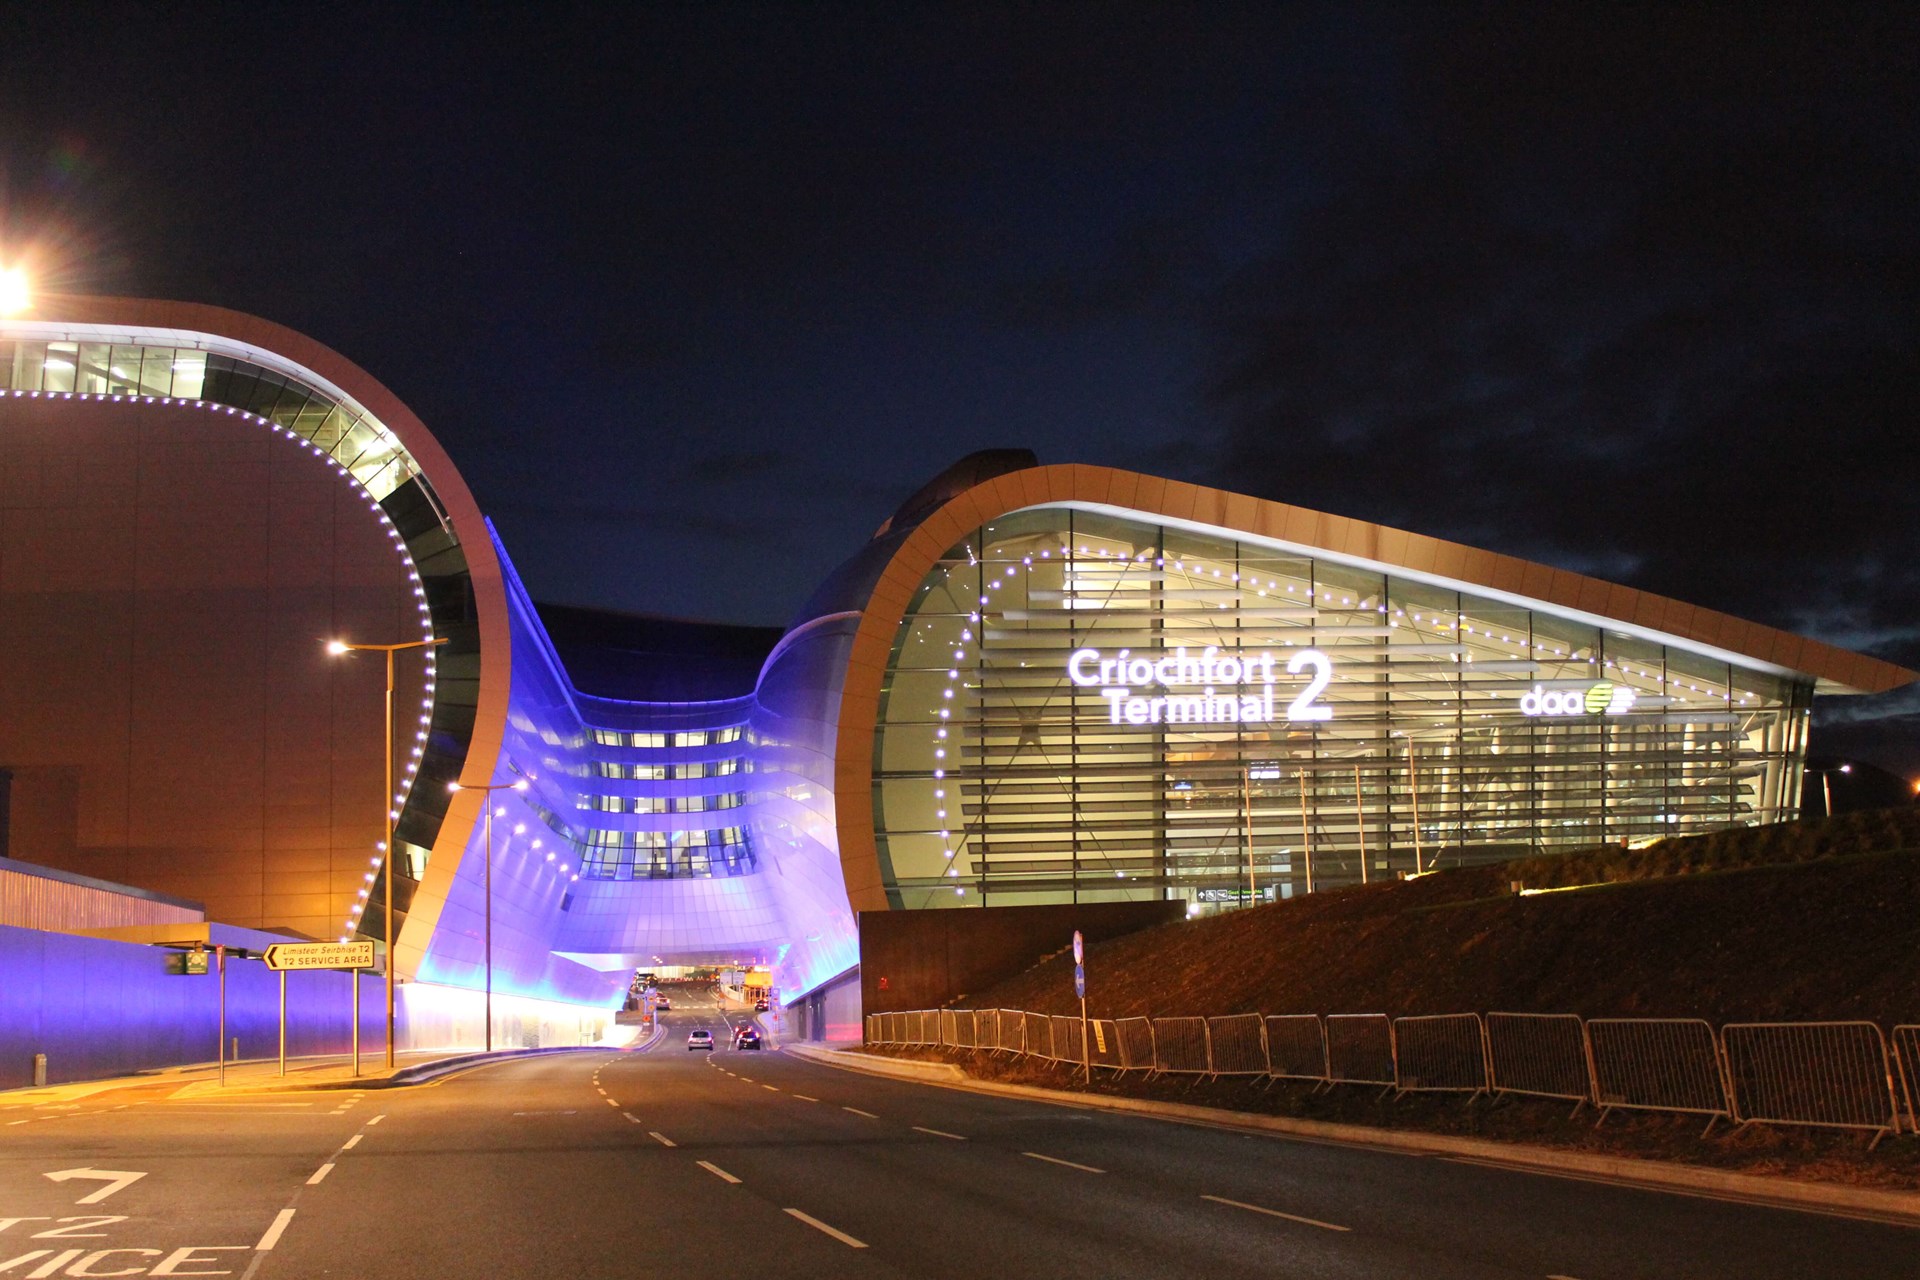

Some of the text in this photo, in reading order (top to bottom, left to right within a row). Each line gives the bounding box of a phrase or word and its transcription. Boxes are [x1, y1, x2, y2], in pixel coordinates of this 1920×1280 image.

[1068, 646, 1276, 686] Críochfort
[1287, 649, 1332, 722] 2
[1520, 685, 1584, 715] daa
[1101, 685, 1274, 724] Terminal
[284, 955, 370, 965] T2 SERVICE AREA
[359, 945, 370, 953] T2
